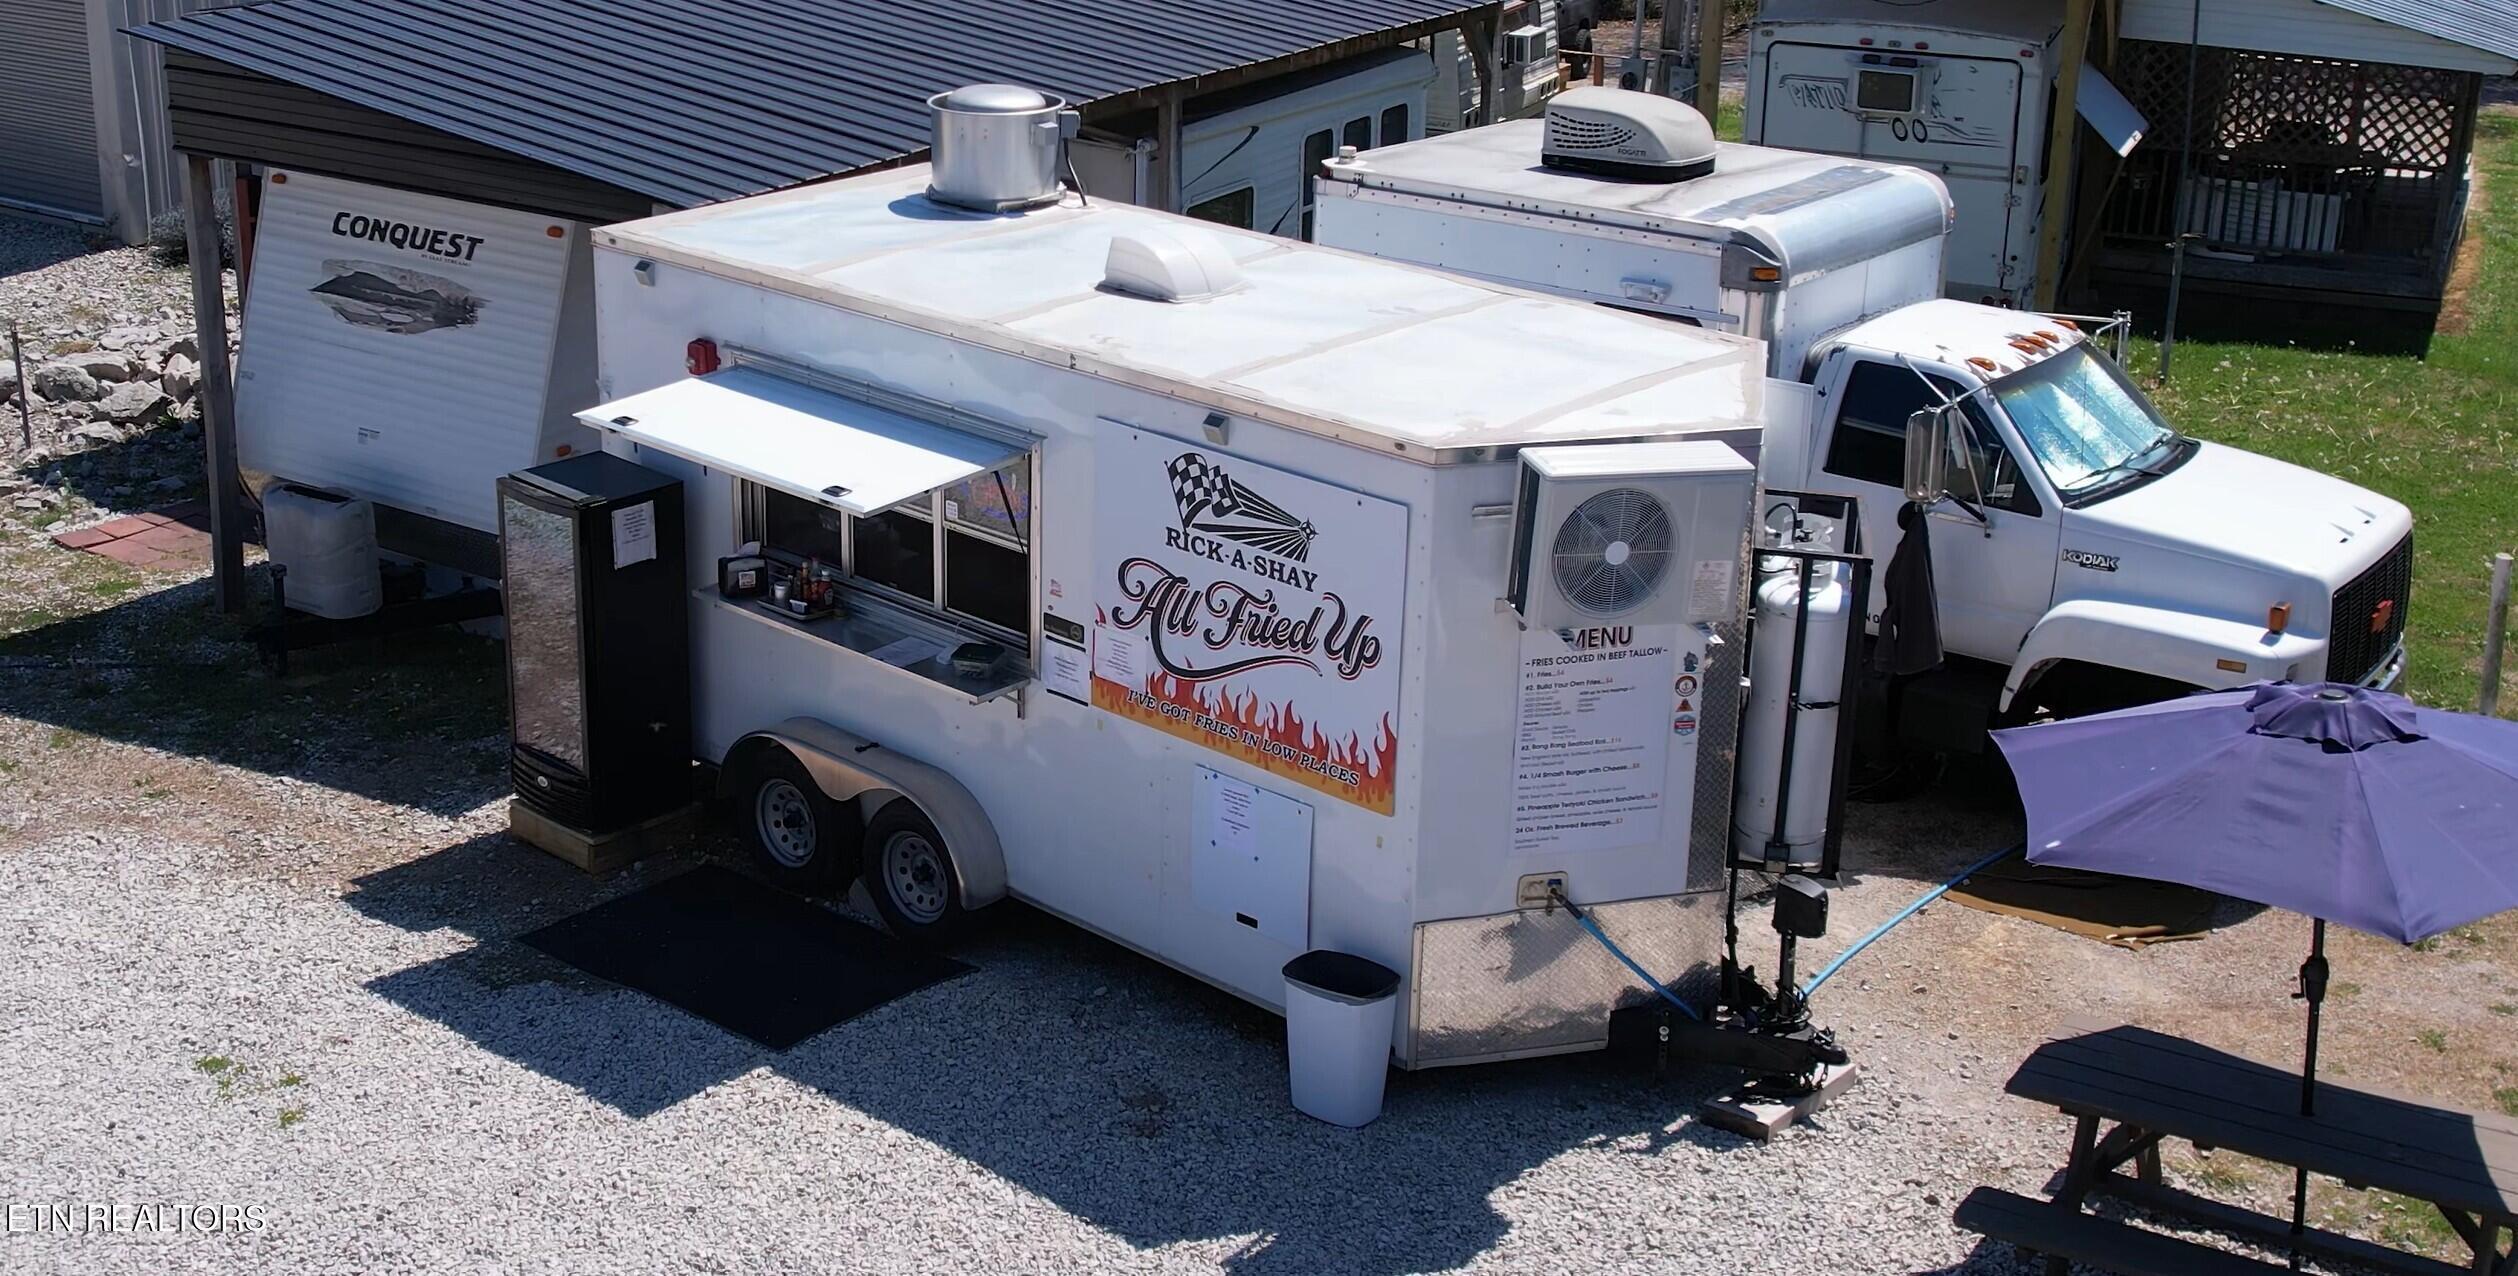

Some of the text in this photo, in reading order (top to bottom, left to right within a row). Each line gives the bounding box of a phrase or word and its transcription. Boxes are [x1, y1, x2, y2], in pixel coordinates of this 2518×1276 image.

[332, 212, 485, 261] CONQUEST
[2062, 549, 2120, 569] KODIAK
[1203, 580, 1325, 654] Fried
[1322, 591, 1382, 681] Up
[1556, 654, 1594, 665] COOKED
[1597, 652, 1607, 661] IN
[1608, 650, 1627, 660] BEEF
[1537, 682, 1553, 690] Build
[1554, 681, 1569, 689] Your
[1570, 680, 1585, 688] Own
[1128, 689, 1360, 786] I'VE GOT FRIES IN LOW PLACES
[1543, 769, 1564, 778] Smash
[1566, 768, 1587, 778] Burger
[1528, 802, 1560, 812] Pineapple
[1587, 797, 1614, 806] Chicken
[1536, 823, 1553, 832] Fresh
[1554, 821, 1579, 830] Brewed
